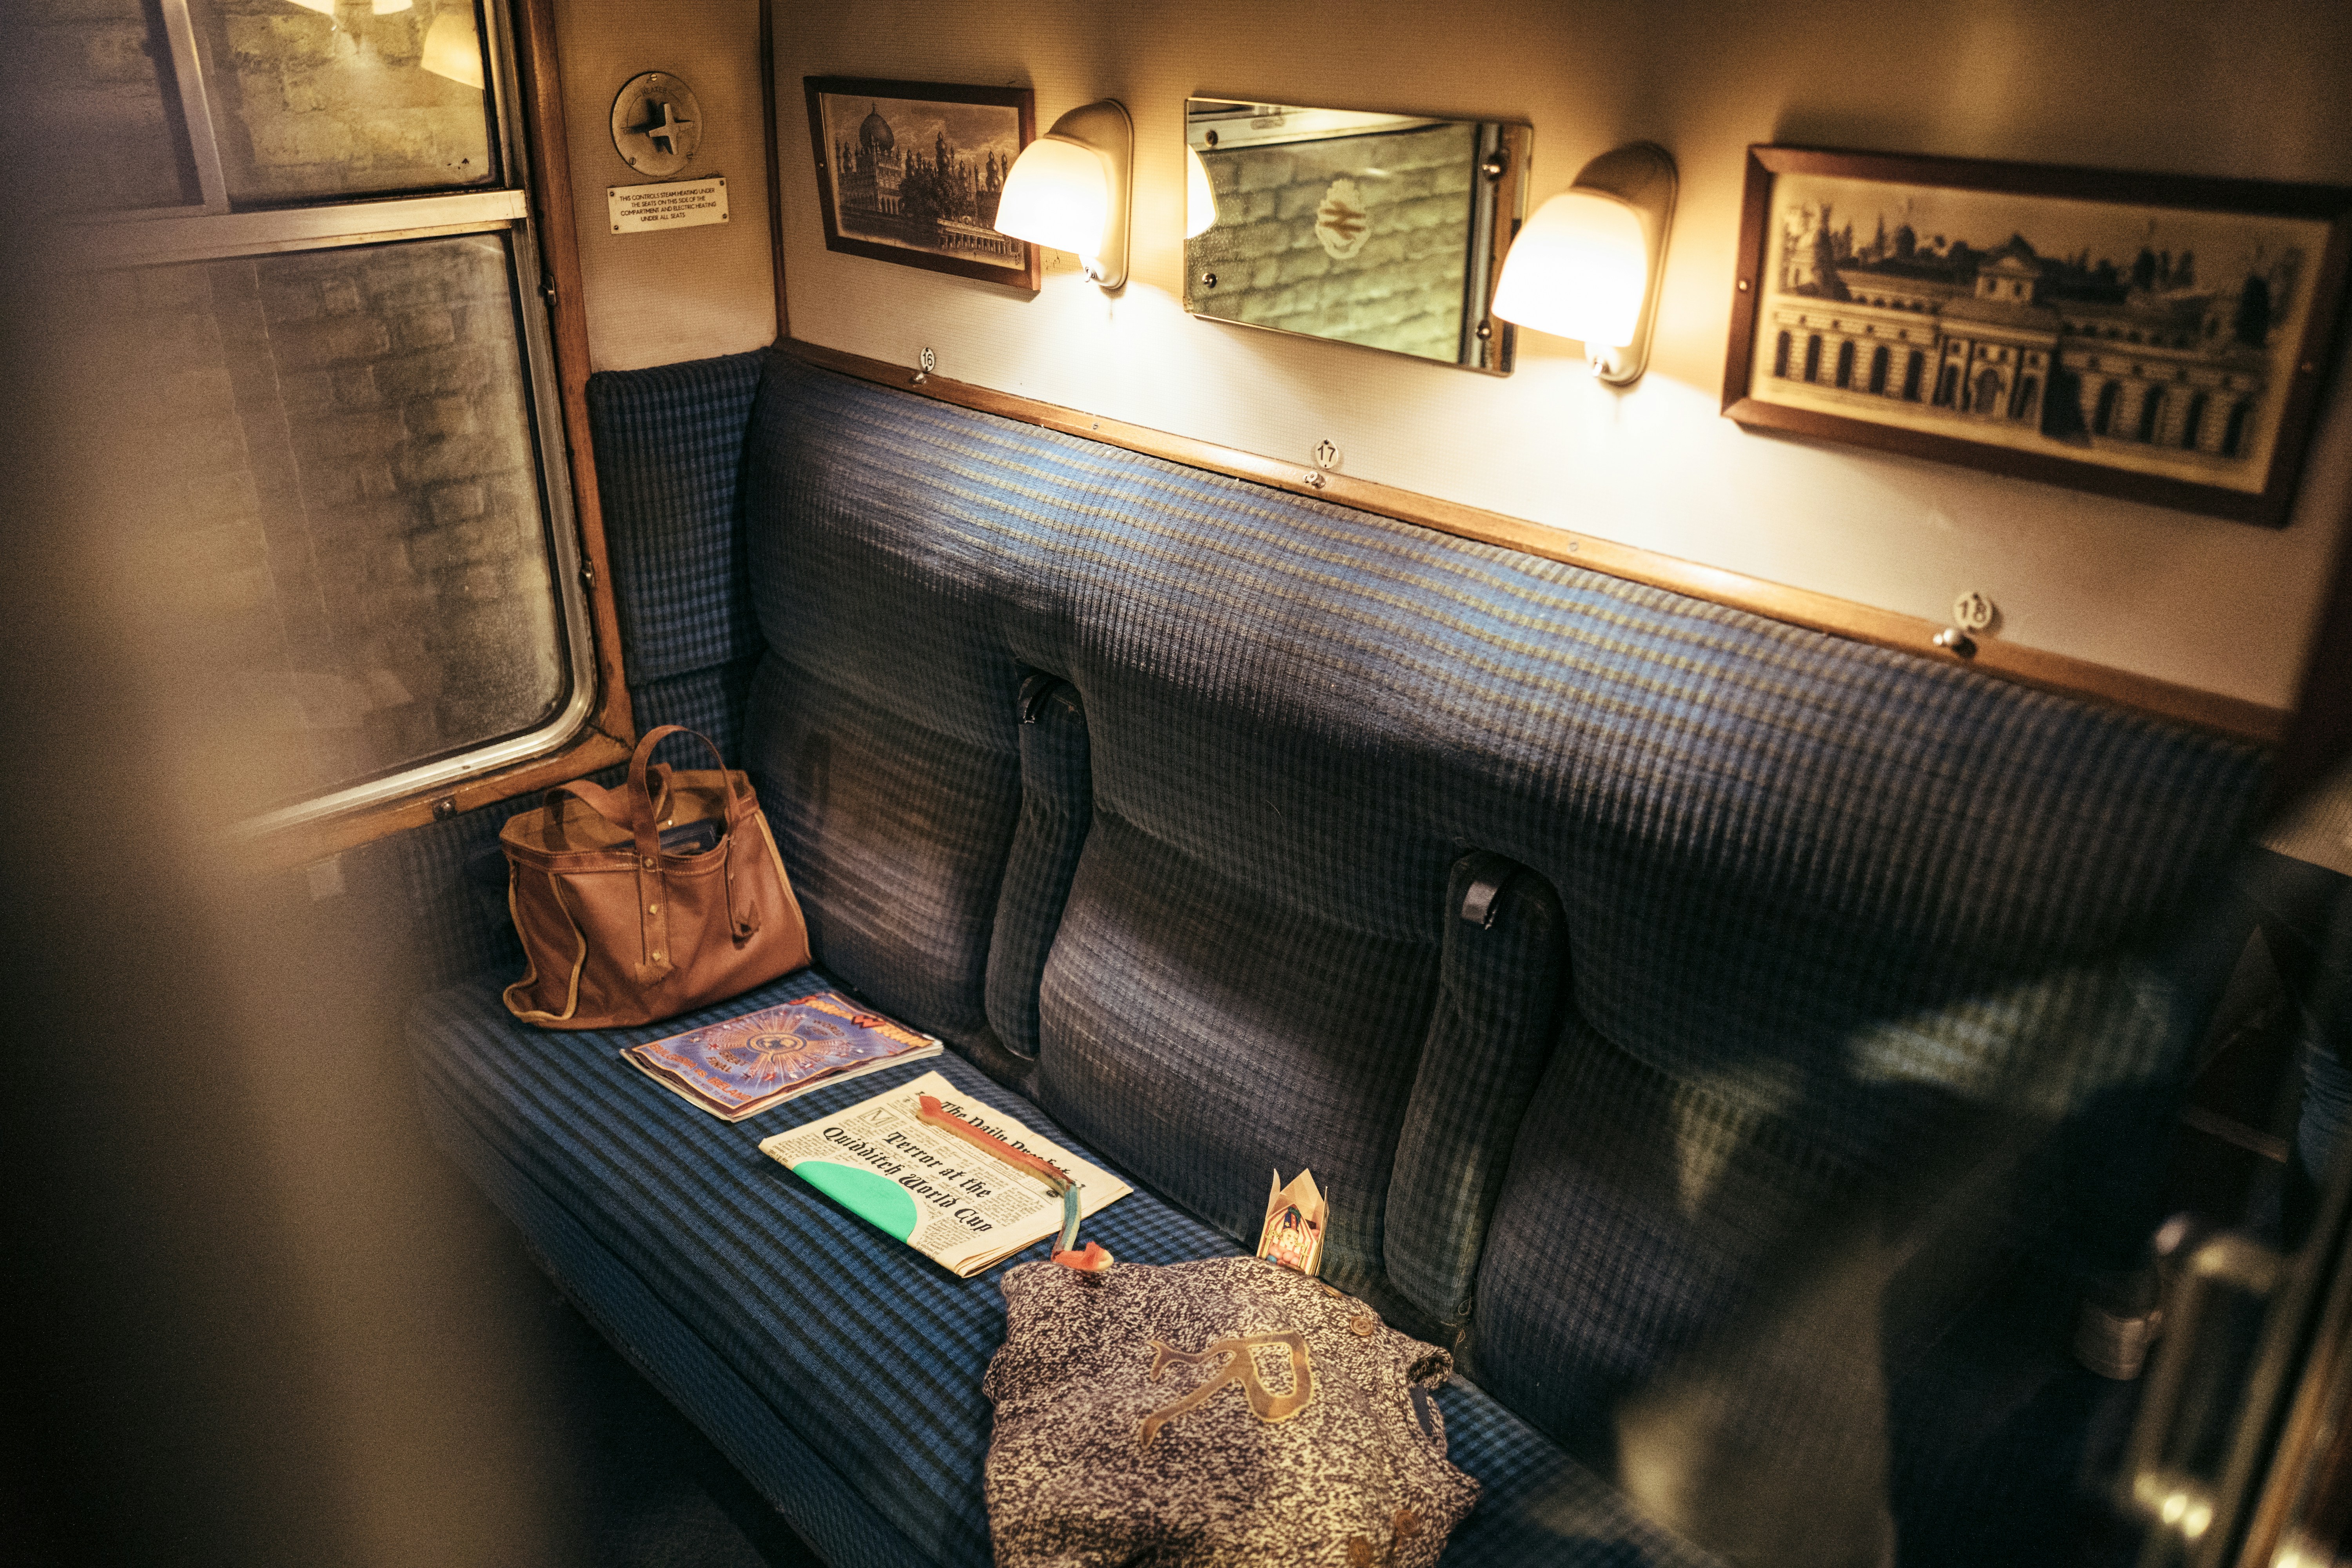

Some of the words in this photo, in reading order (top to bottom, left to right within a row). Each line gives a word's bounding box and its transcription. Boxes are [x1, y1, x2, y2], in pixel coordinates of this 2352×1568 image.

[621, 207, 659, 216] COMPARTMENT
[923, 352, 933, 366] 16
[1318, 445, 1336, 462] 17
[1959, 600, 1987, 623] 18
[706, 1056, 732, 1074] FINAL
[706, 1077, 752, 1101] IRELAND
[941, 1102, 967, 1118] The
[882, 1131, 943, 1167] Terror
[938, 1169, 967, 1181] at
[959, 1178, 992, 1198] the
[823, 1127, 905, 1176] Quidditch
[898, 1174, 960, 1208] World
[954, 1209, 994, 1232] Cup
